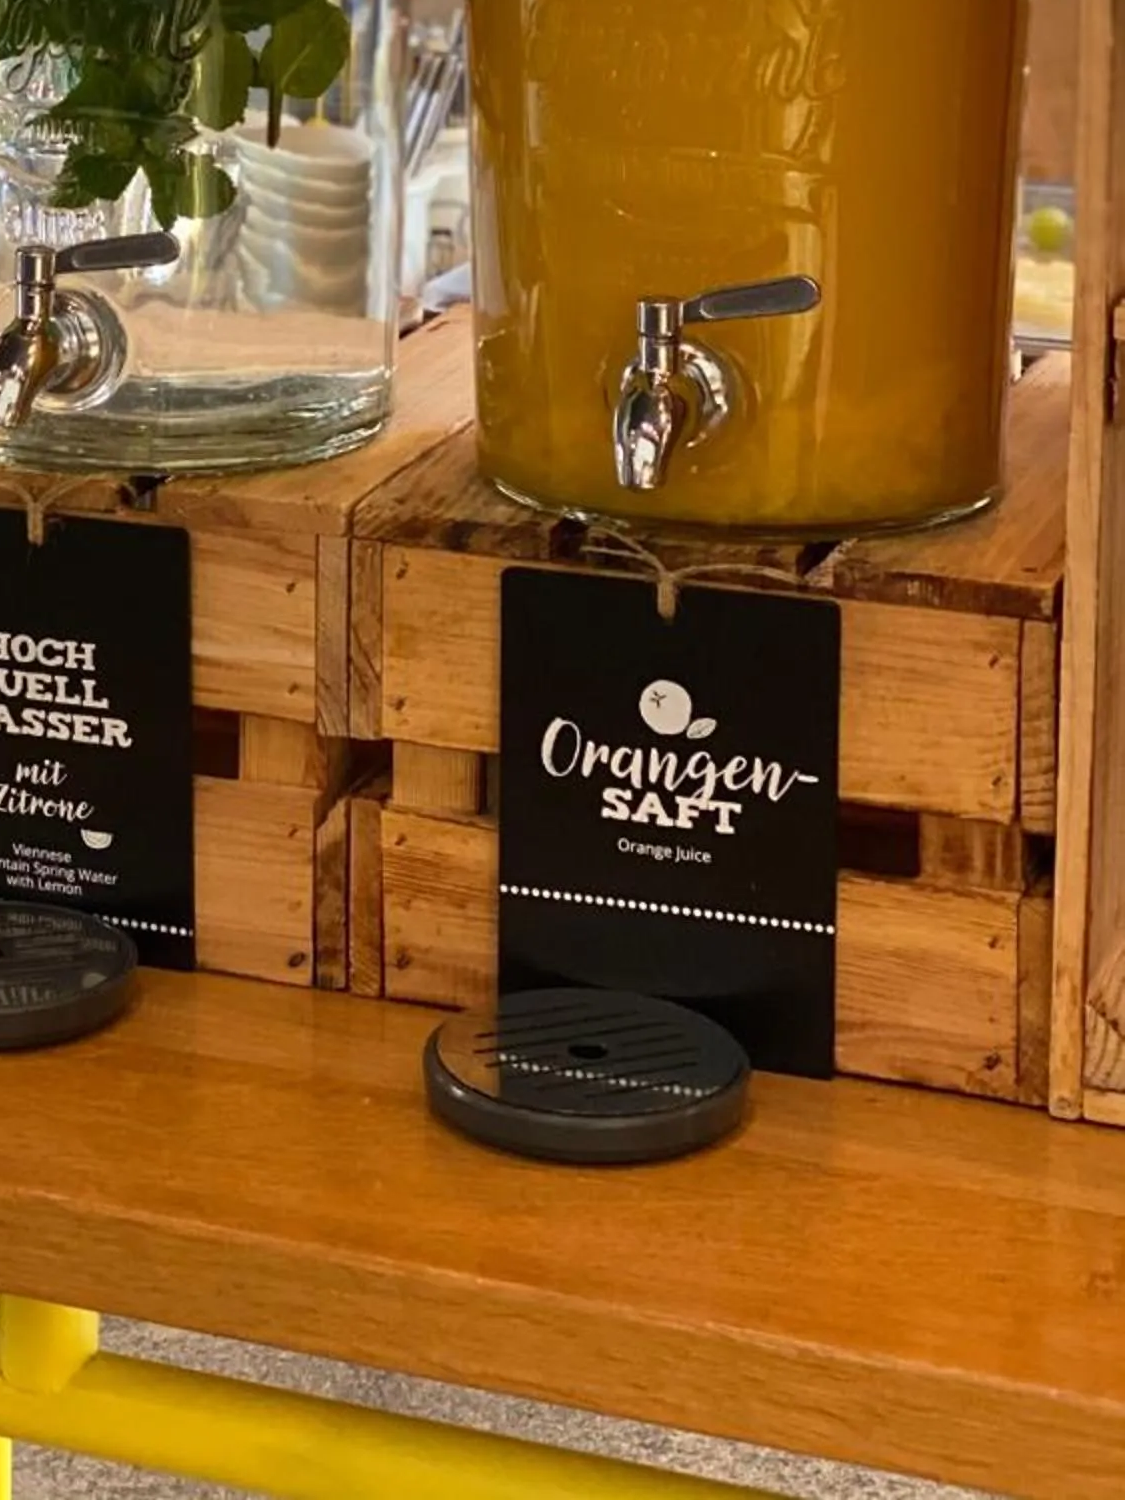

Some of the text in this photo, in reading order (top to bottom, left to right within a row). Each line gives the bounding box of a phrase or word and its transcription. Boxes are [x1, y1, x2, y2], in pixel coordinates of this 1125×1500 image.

[15, 758, 68, 786] mit
[541, 716, 819, 808] Orangen-
[600, 787, 743, 835] SAFT
[12, 842, 73, 864] Viennese
[618, 837, 713, 864] Orange Juice
[6, 874, 83, 896] with Lemon
[33, 861, 76, 883] Spring
[78, 867, 118, 886] Water
